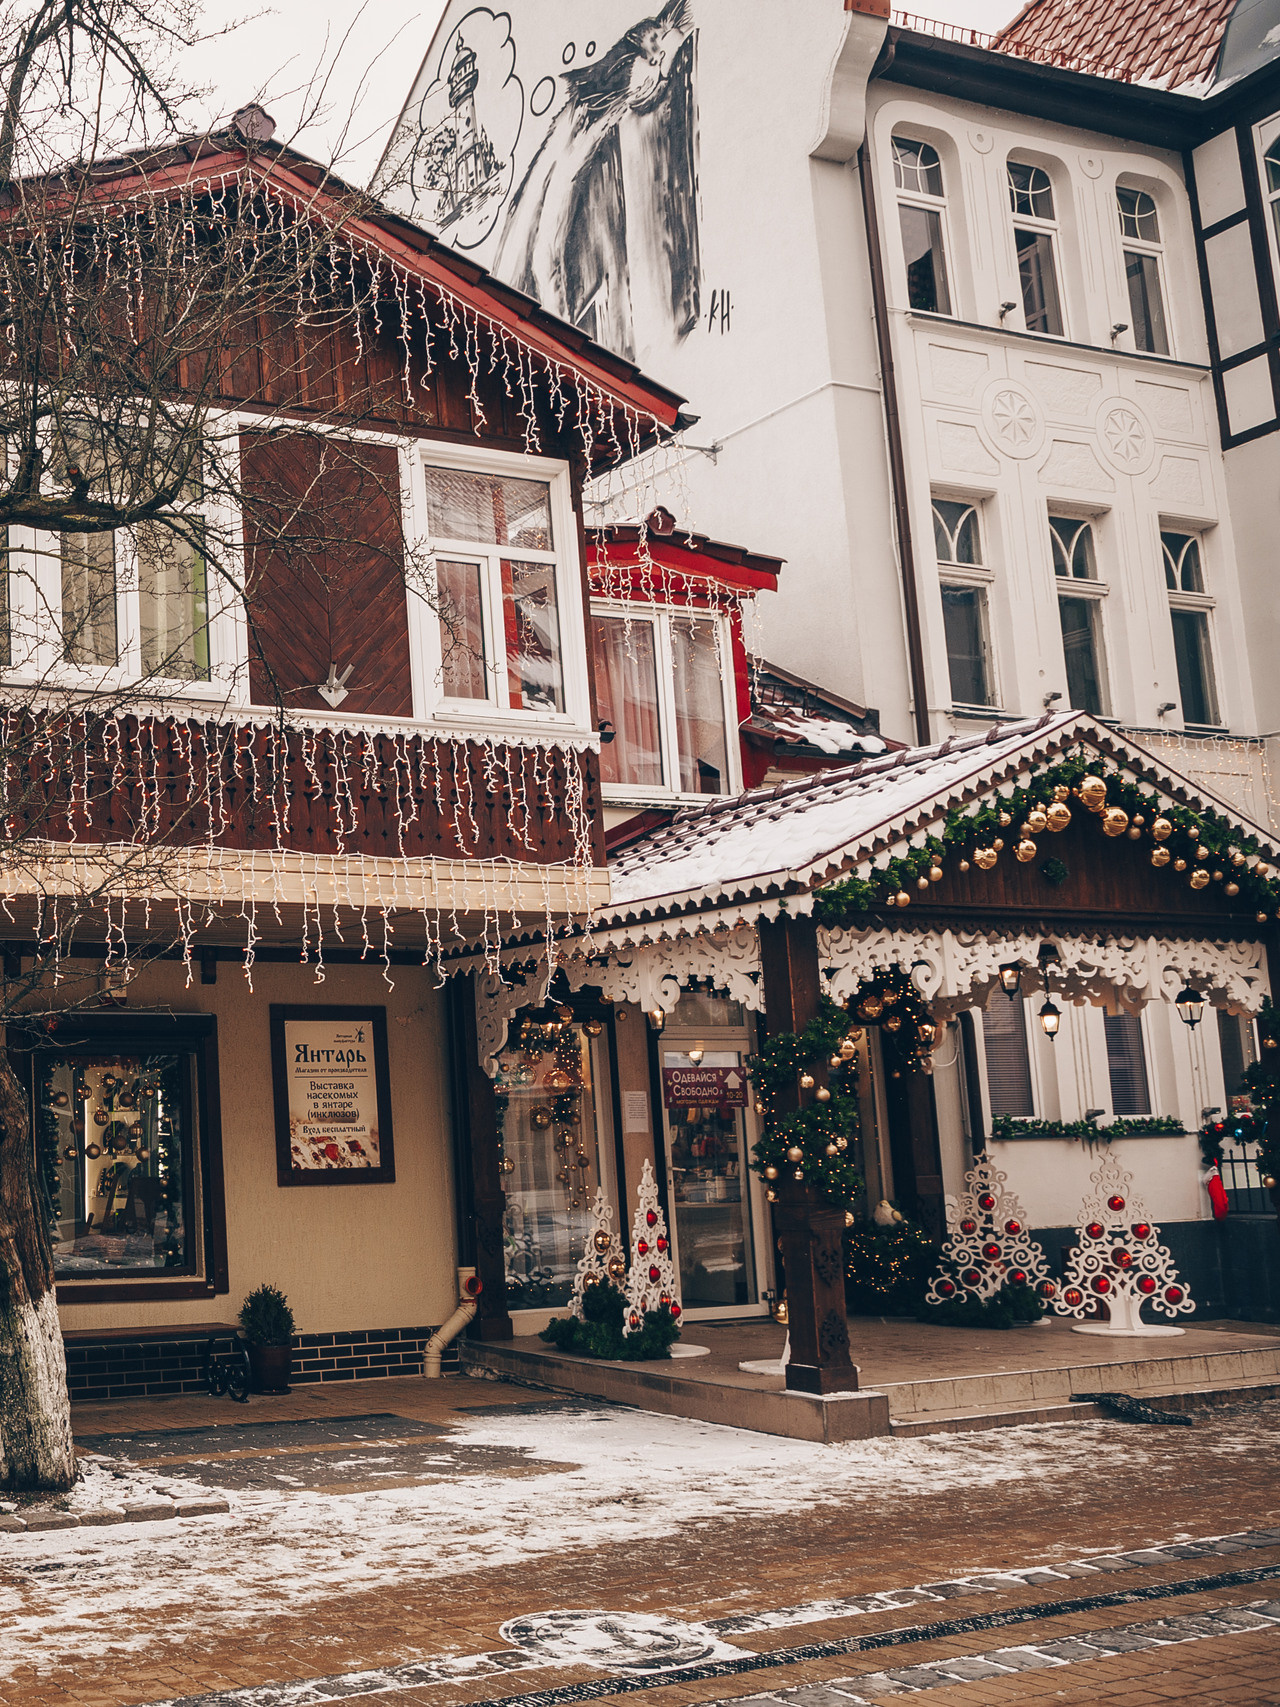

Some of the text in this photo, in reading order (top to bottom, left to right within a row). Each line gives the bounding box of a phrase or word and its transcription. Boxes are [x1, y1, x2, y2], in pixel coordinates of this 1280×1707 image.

[294, 1043, 367, 1068] Янтарь
[310, 1080, 355, 1091] Выставка
[306, 1091, 358, 1100] насекомых
[726, 1091, 744, 1099] 10-20
[322, 1101, 353, 1110] янтаре
[307, 1108, 360, 1121] (инклюзов)
[302, 1124, 366, 1135] Вход бесплатный
